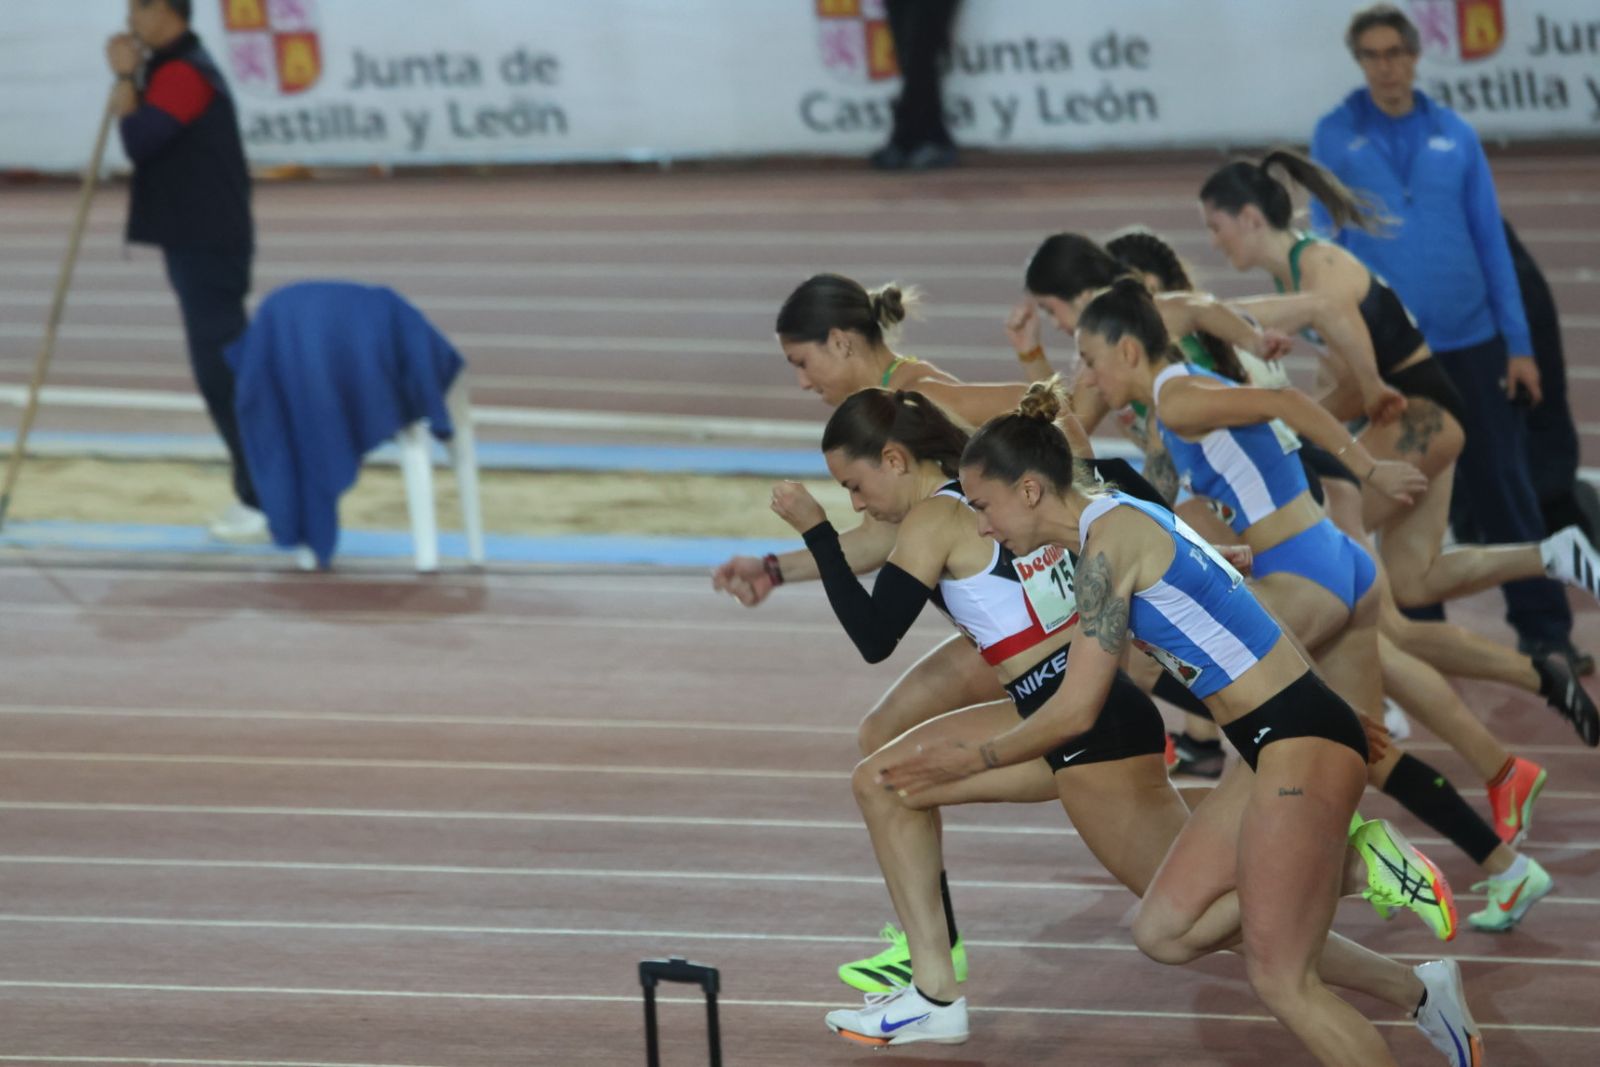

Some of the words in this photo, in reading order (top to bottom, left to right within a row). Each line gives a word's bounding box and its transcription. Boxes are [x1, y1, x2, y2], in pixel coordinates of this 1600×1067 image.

[347, 50, 482, 90] Junta
[500, 48, 559, 86] de
[1089, 30, 1151, 71] de
[990, 94, 1019, 139] y
[1037, 83, 1159, 127] León
[1432, 68, 1568, 112] astilla
[244, 103, 387, 145] astilla
[403, 108, 430, 151] y
[1015, 650, 1068, 699] NIKE
